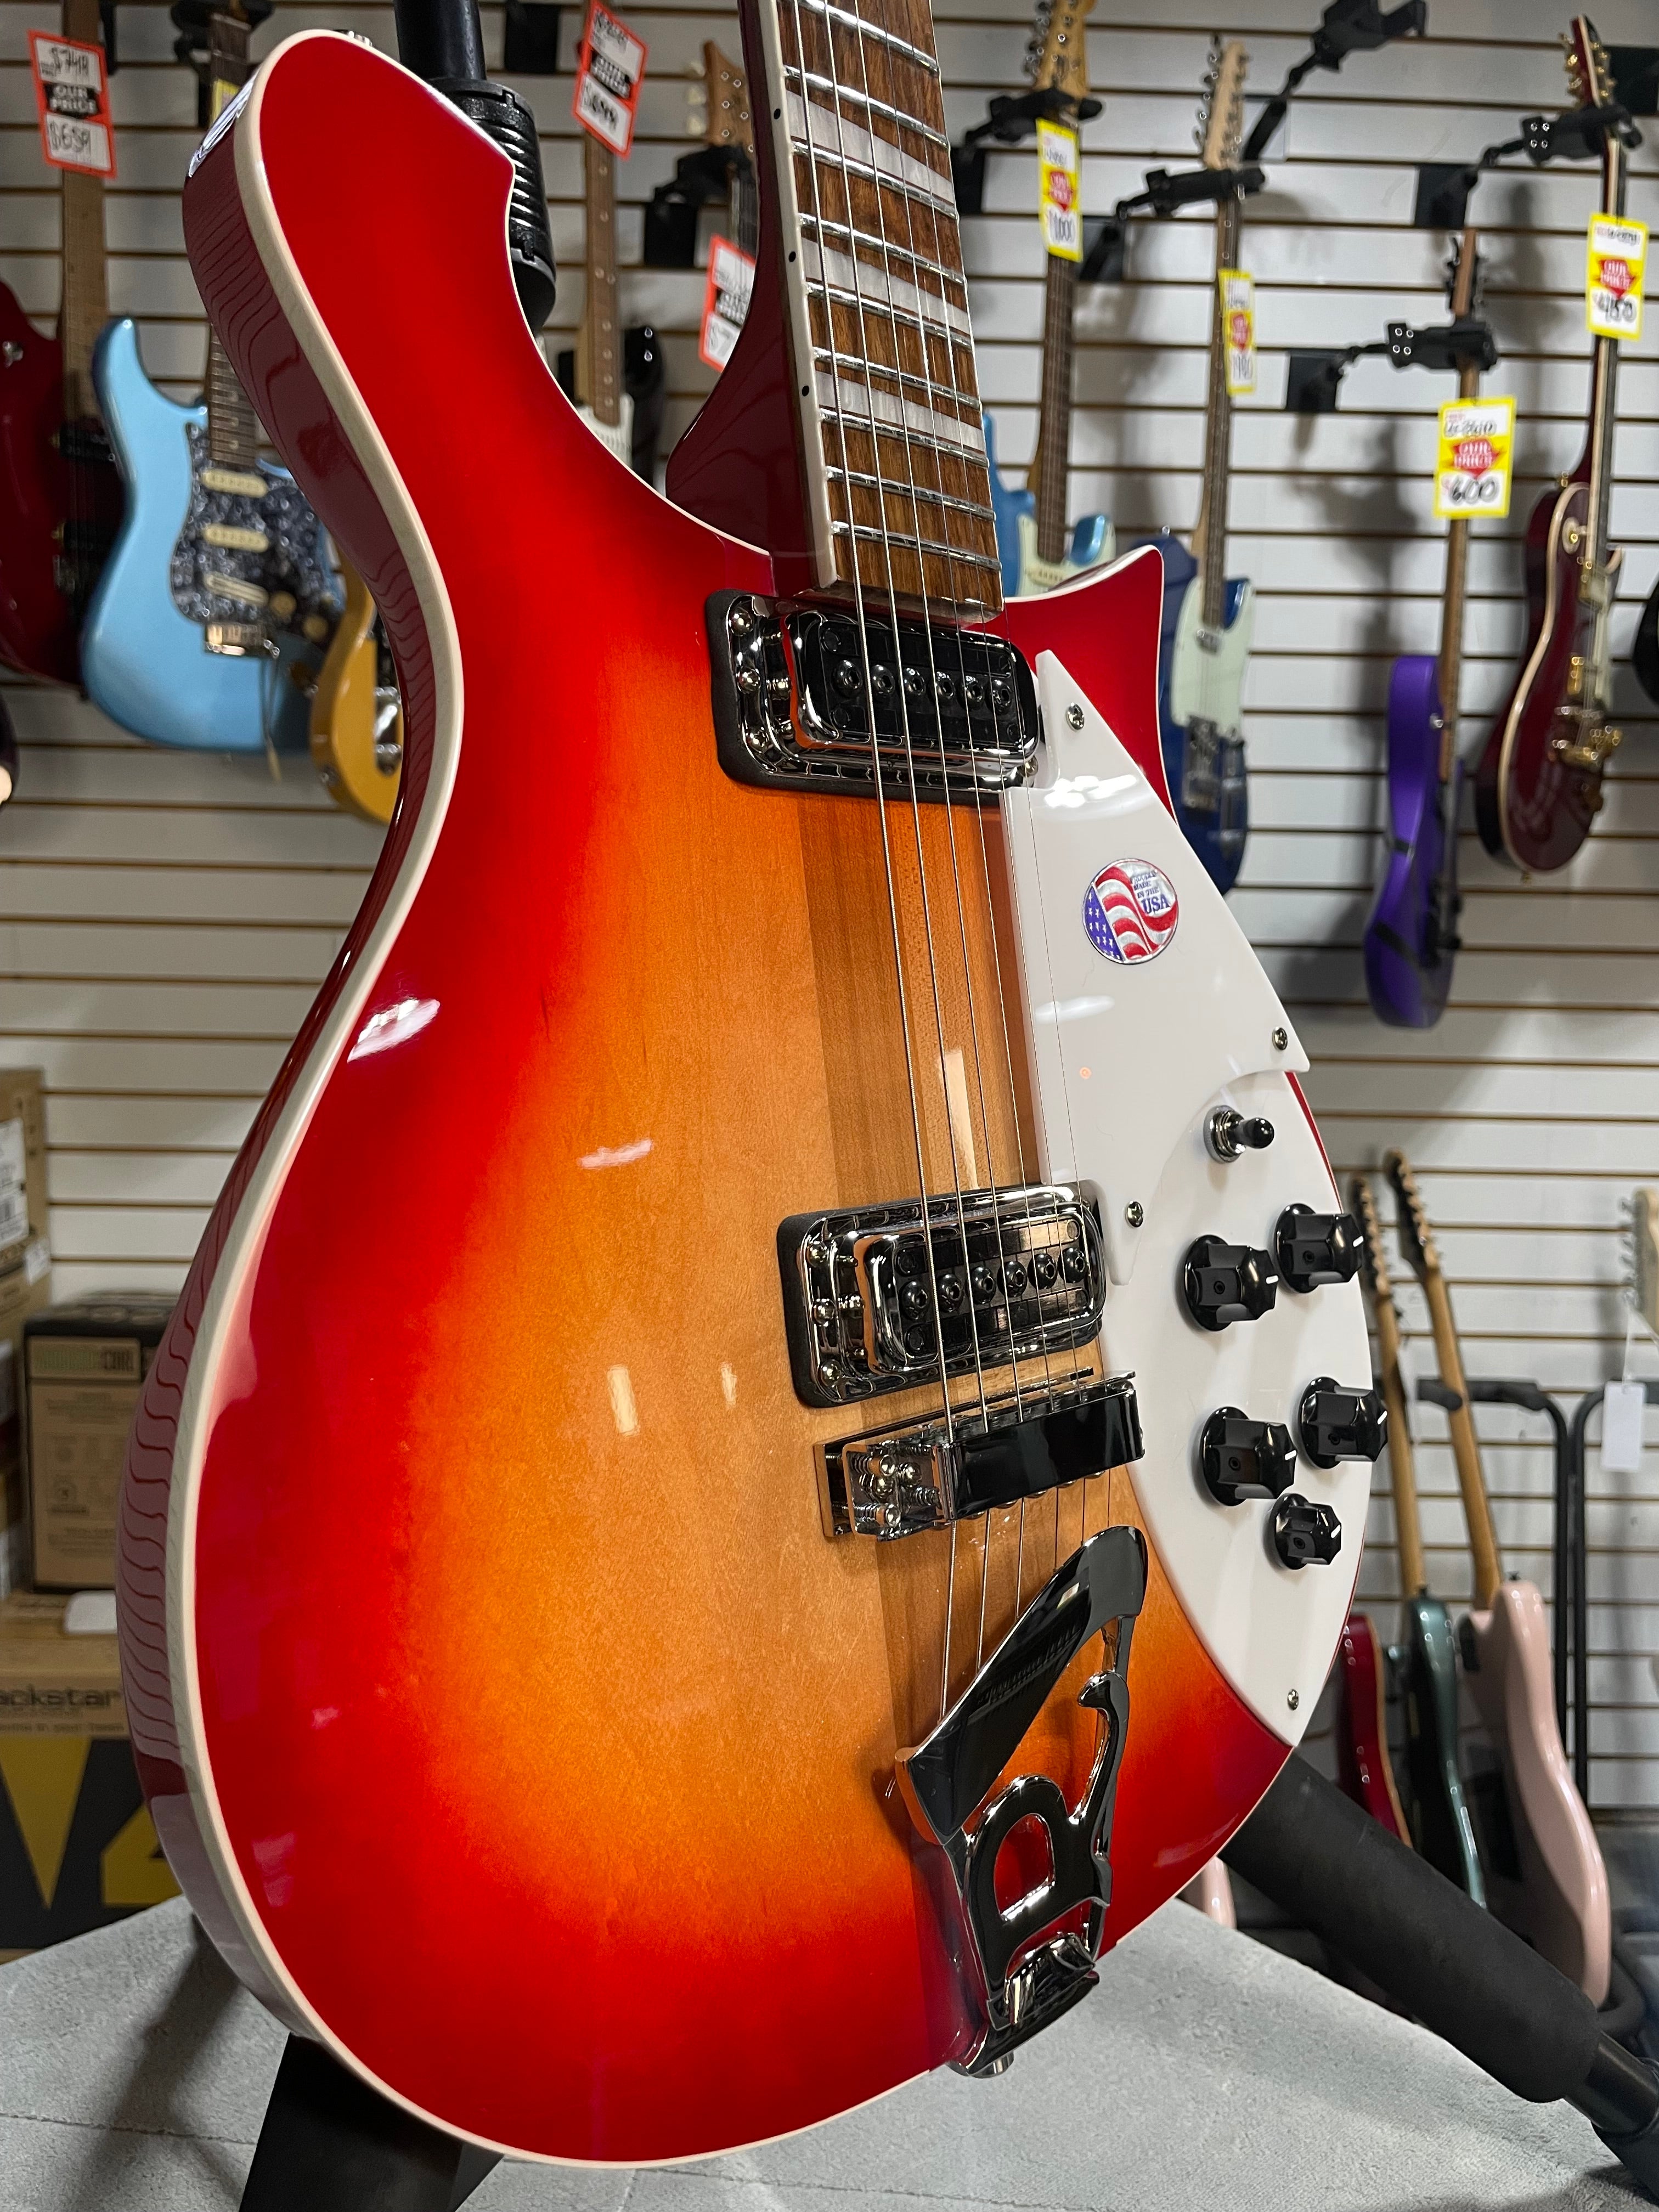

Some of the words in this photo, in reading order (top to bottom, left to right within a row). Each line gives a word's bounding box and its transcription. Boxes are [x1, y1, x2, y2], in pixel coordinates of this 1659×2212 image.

[53, 84, 88, 100] OUR
[49, 97, 98, 114] PRICE
[1133, 881, 1152, 890] MADE
[1145, 887, 1159, 896] THE
[1141, 894, 1170, 914] USA
